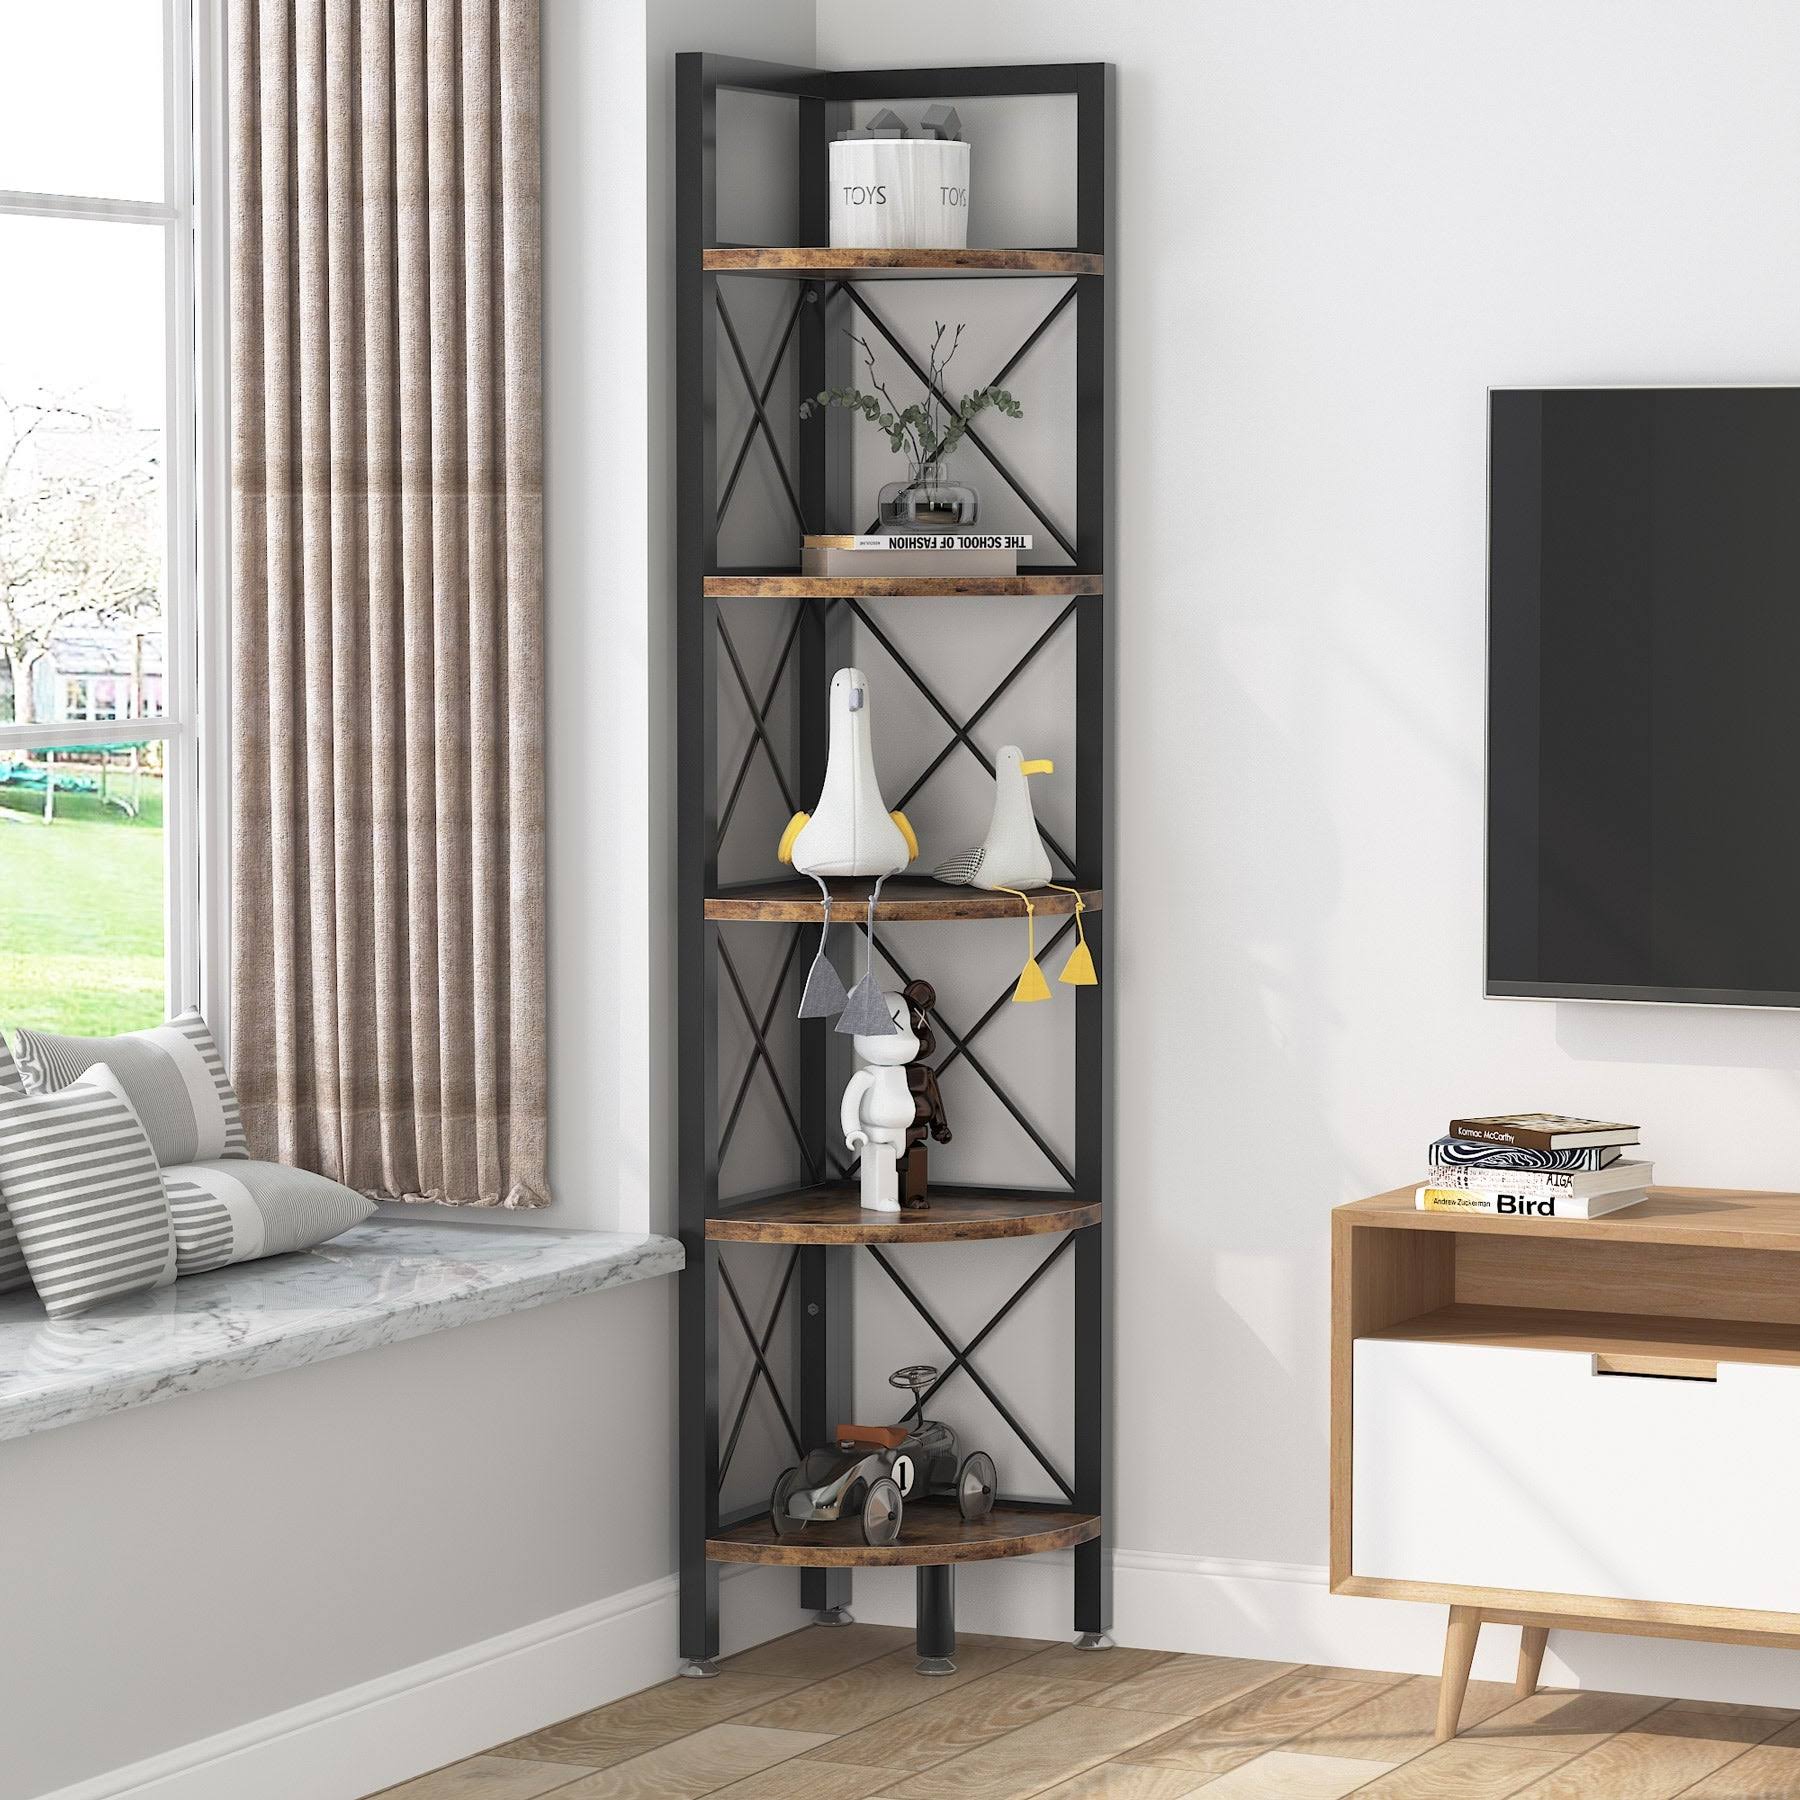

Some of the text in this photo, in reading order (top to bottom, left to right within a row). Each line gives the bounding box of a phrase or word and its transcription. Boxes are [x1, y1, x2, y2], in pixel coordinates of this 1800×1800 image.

[843, 186, 887, 205] TOYS
[889, 537, 936, 549] FASHION
[940, 537, 954, 549] OF
[957, 537, 1001, 549] SCHOOL
[1005, 537, 1026, 549] THE
[1483, 1128, 1515, 1143] McCarthy
[1546, 1173, 1573, 1188] AIGA
[1433, 1194, 1555, 1216] Andrew Zuckerman Bird
[899, 1461, 907, 1491] 1
